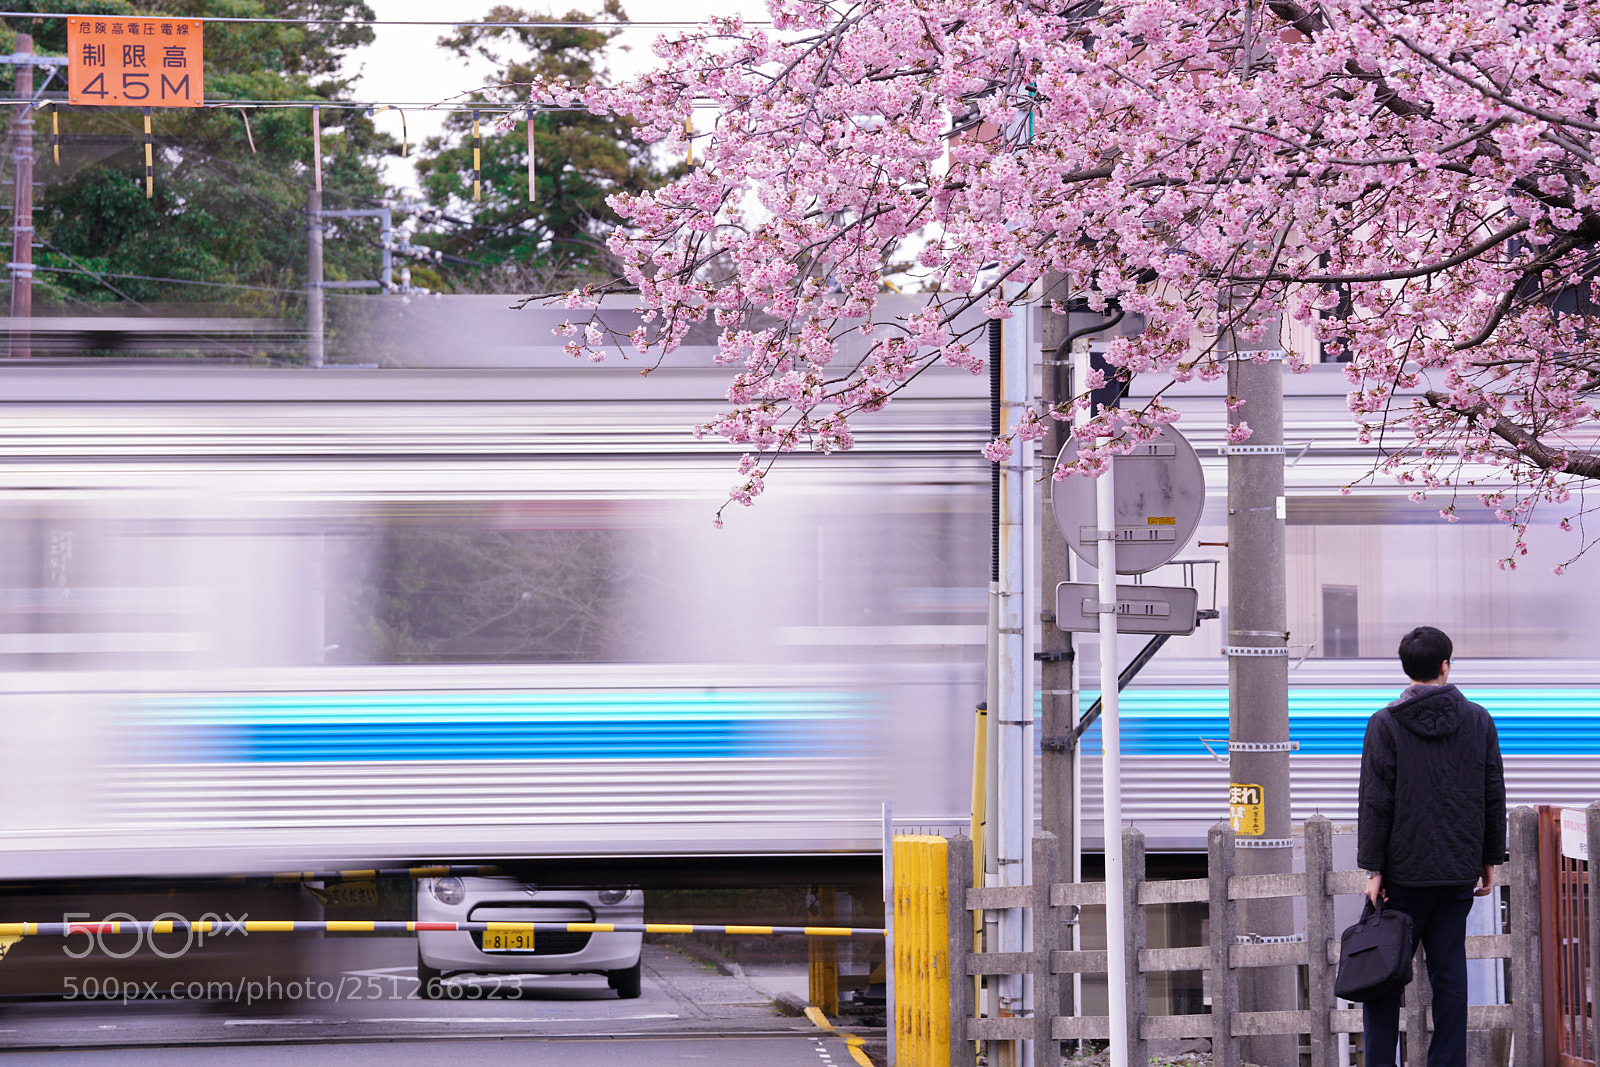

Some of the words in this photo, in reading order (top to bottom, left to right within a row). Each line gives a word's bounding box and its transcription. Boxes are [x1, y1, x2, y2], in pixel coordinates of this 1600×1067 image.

[79, 21, 190, 36] 危険高電圧電線
[82, 43, 187, 68] 制限高
[81, 72, 190, 100] 4.5M
